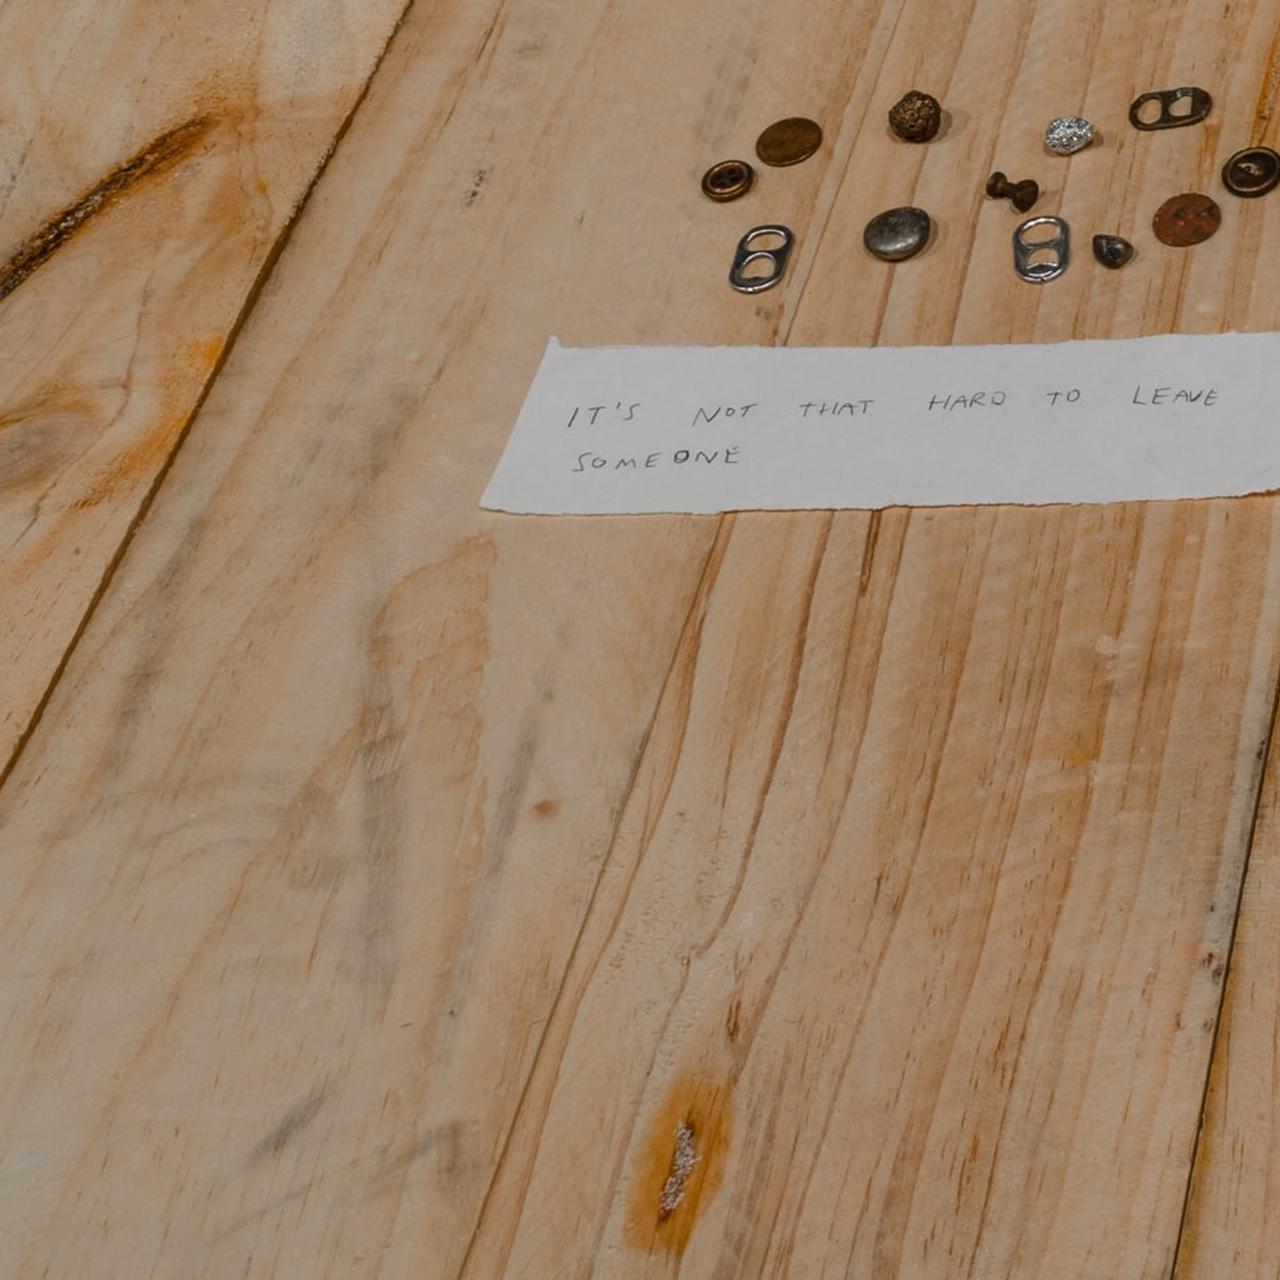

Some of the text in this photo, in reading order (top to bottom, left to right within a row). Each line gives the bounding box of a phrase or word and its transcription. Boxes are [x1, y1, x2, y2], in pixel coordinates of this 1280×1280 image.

[568, 386, 1218, 428] IT'S NOT THAT HARD TO LEAVE
[572, 446, 739, 472] SOMEONE
